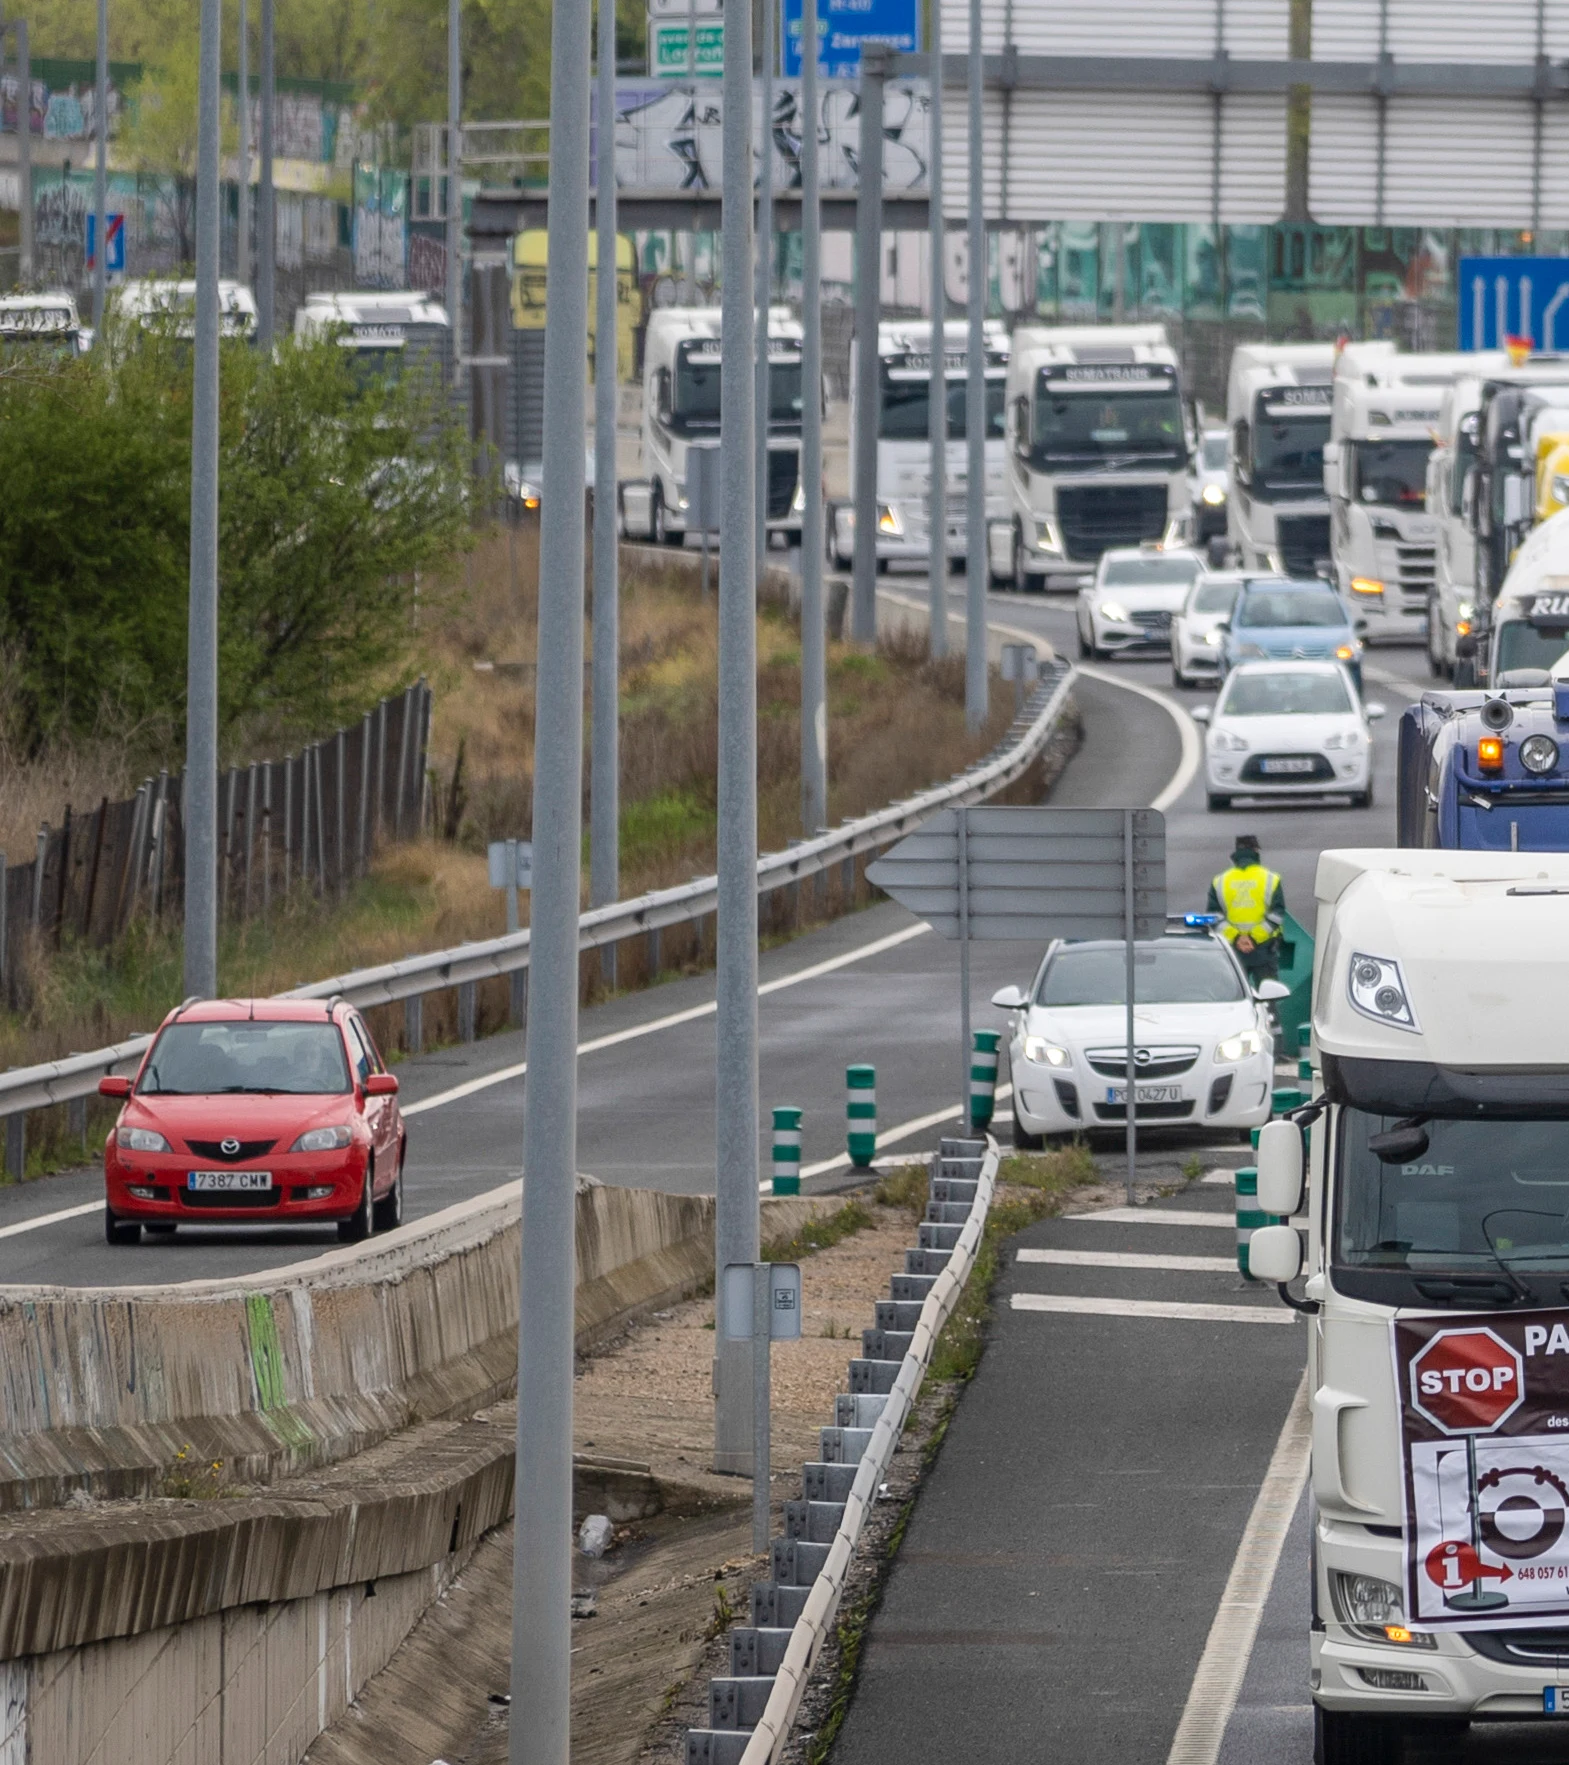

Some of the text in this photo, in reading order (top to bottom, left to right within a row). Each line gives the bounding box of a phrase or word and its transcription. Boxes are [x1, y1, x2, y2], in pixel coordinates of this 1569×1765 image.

[1169, 1088, 1177, 1100] U
[1401, 1164, 1454, 1176] DAF
[198, 1174, 268, 1188] 7387 CMW
[1420, 1366, 1514, 1395] STOP
[1517, 1568, 1535, 1580] 648
[1537, 1567, 1554, 1579] 057
